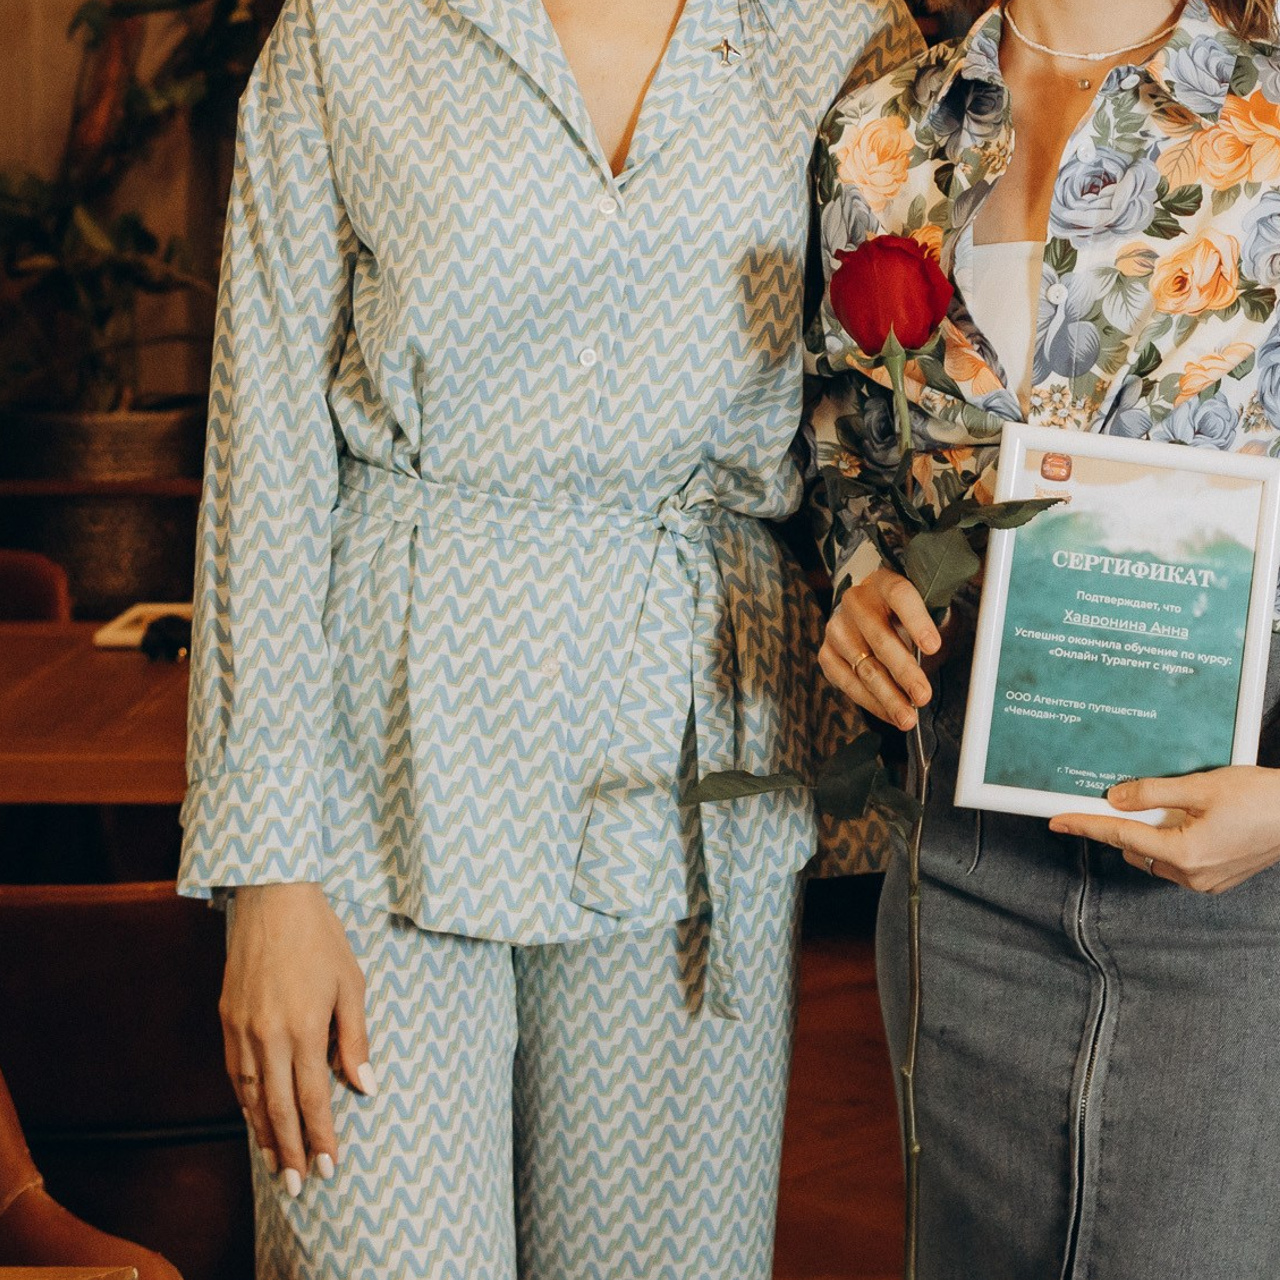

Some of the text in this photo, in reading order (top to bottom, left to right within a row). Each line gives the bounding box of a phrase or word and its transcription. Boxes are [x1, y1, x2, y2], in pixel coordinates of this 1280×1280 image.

[1052, 550, 1214, 588] СЕРТИФИКАТ
[1076, 590, 1182, 614] Подтверждает, что
[1064, 609, 1189, 638] Хавронина Анна
[1014, 627, 1232, 666] Успешно окончила обучение по курсу:
[1048, 647, 1098, 663] «Онлайн
[1101, 654, 1151, 669] Турагент
[1162, 664, 1195, 675] нуля»
[1004, 704, 1082, 723] «Чемодан-тур»
[1005, 690, 1157, 719] ООО Агентство путешествий
